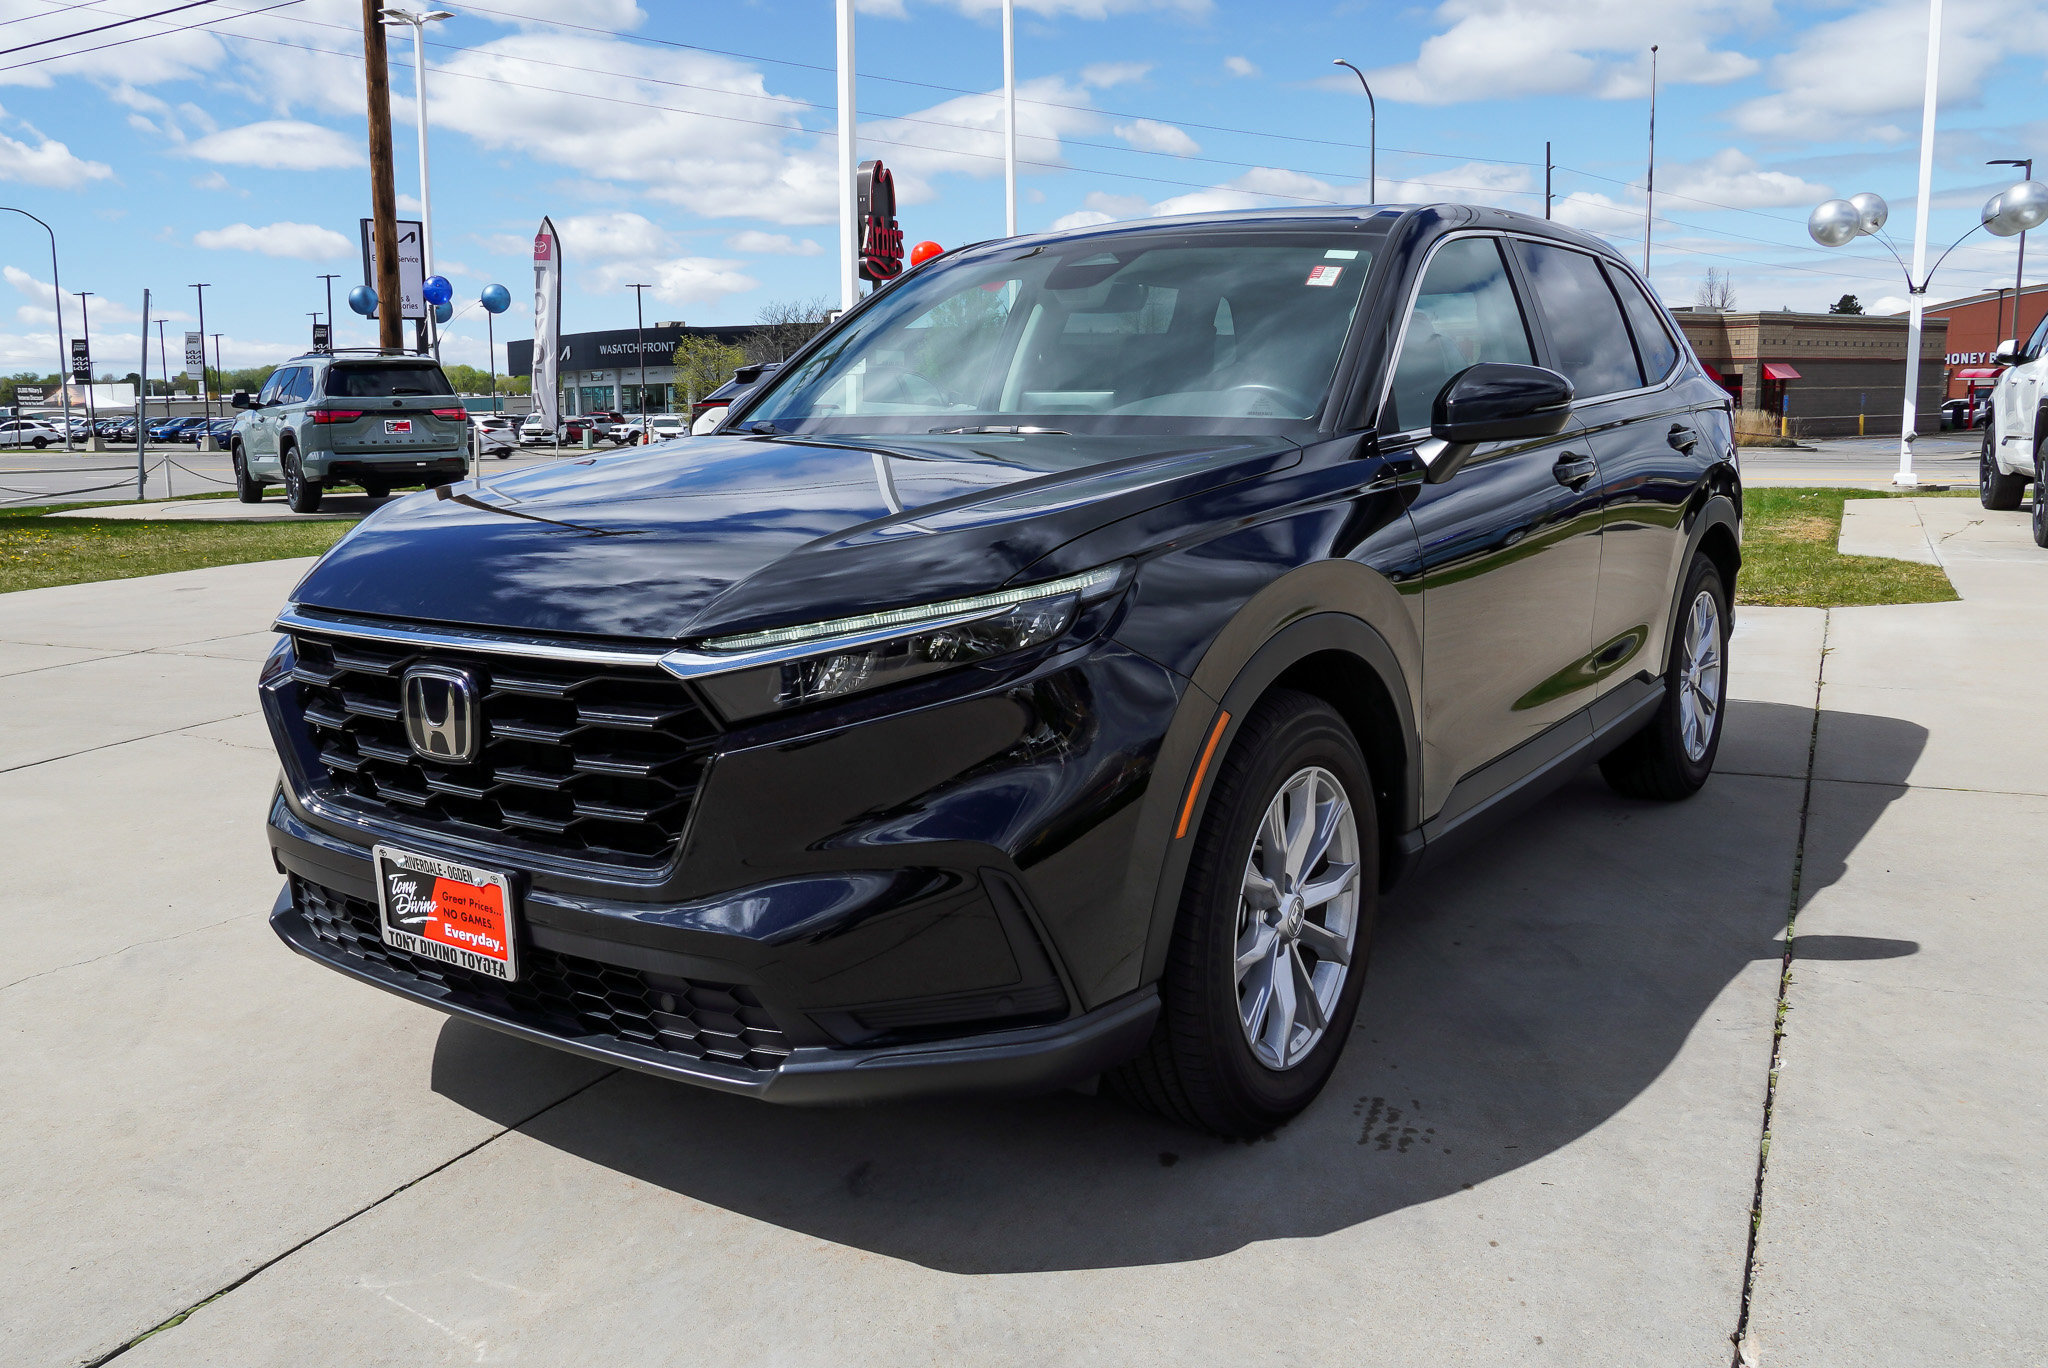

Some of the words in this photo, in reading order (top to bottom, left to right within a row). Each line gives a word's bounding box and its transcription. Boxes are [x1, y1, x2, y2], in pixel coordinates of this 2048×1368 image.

[865, 215, 904, 268] Arby's
[600, 343, 639, 354] WASATCH
[642, 341, 676, 352] FRONT
[1944, 352, 1986, 364] HONEY
[403, 855, 443, 876] RIVERDALE
[447, 865, 473, 883] OGDEN
[388, 874, 418, 898] Tony
[391, 894, 438, 914] Divino
[442, 891, 466, 906] Great
[469, 898, 502, 917] Prices...
[443, 908, 458, 920] NO
[460, 912, 495, 930] GAMES.
[444, 923, 504, 952] Everyday.
[388, 931, 420, 952] TONY
[420, 941, 458, 964] DIVINO
[460, 951, 507, 979] TOYOTA
